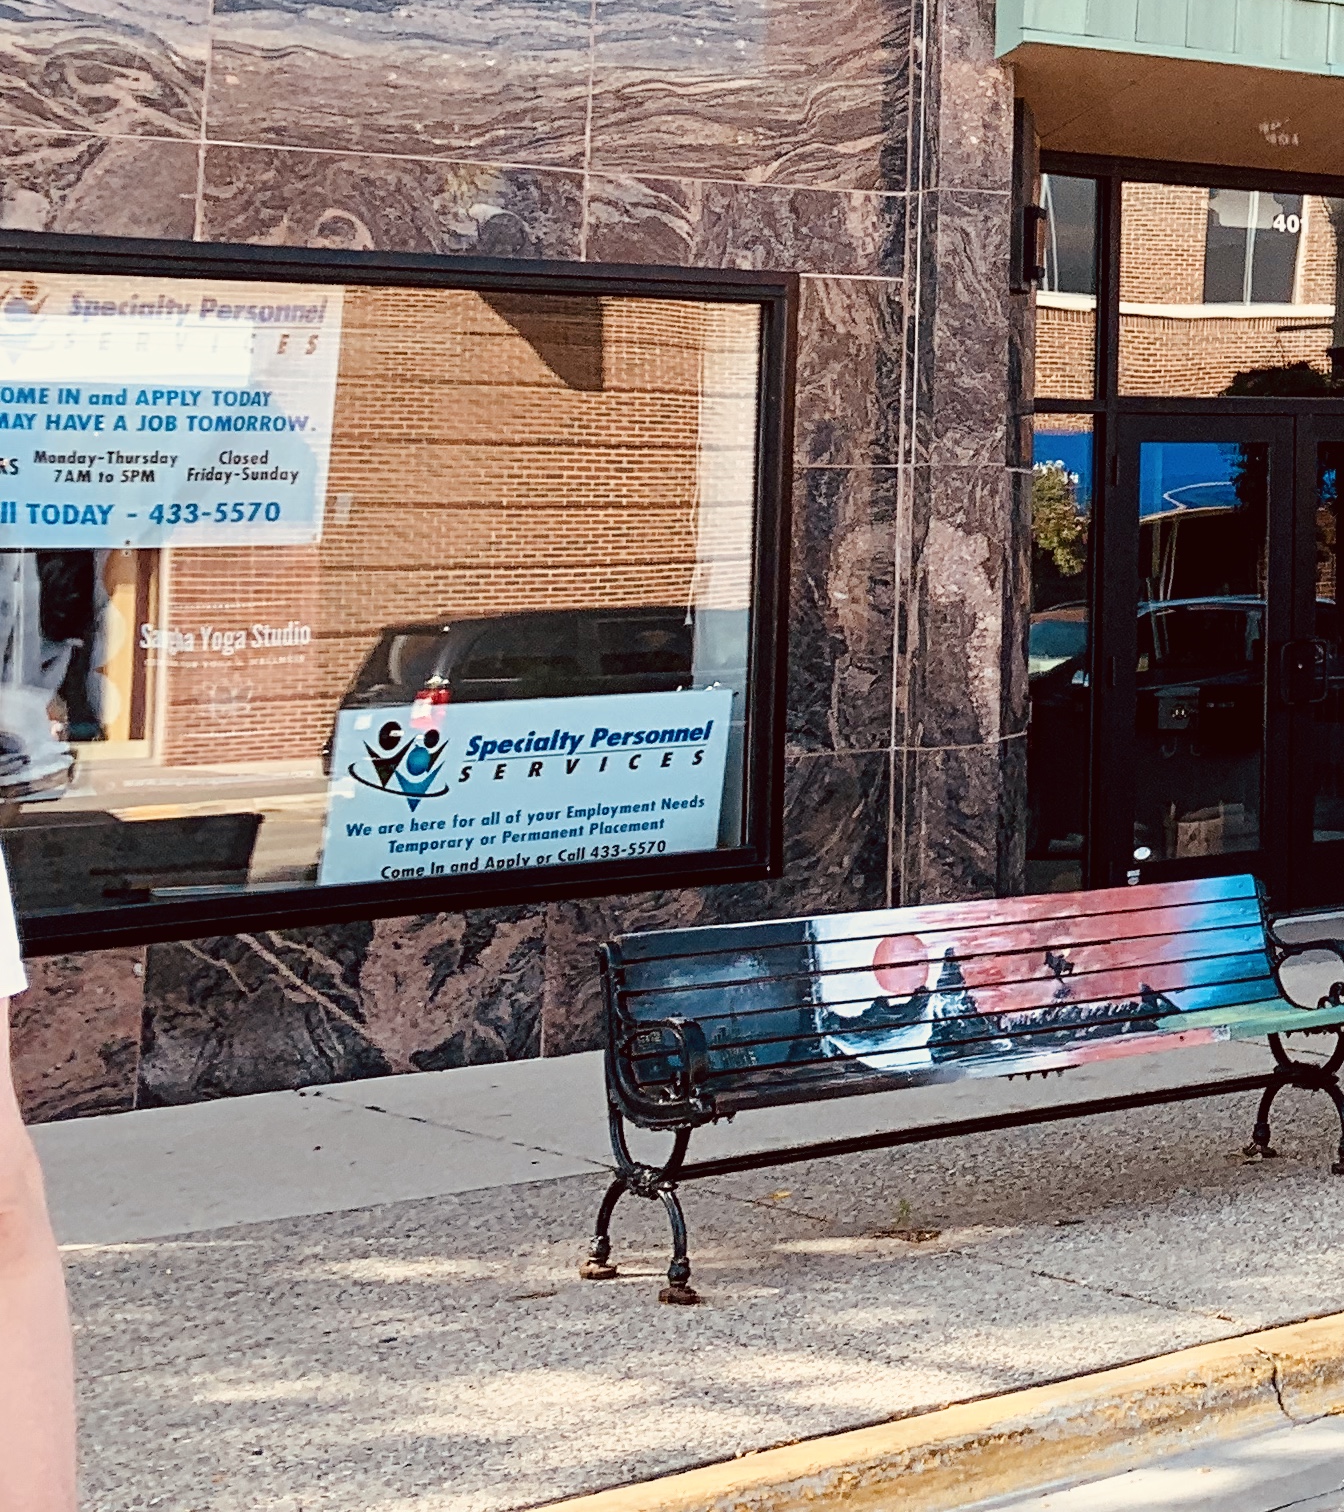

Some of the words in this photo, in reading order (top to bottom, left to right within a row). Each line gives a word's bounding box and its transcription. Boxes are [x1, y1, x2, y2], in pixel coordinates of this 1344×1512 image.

[1272, 214, 1307, 233] 40
[69, 291, 191, 327] Specialty
[199, 294, 328, 324] Personnel
[58, 388, 80, 405] IN
[89, 389, 127, 406] and
[135, 390, 201, 407] APPLY
[211, 390, 273, 407] TODAY
[45, 413, 105, 431] HAVE
[113, 414, 127, 431] A
[136, 415, 177, 432] JOB
[186, 414, 317, 433] TOMORROW.
[33, 450, 178, 467] Monday-Thursday
[218, 449, 269, 465] Closed
[53, 469, 92, 483] 7AM
[99, 469, 114, 483] to
[120, 469, 155, 483] 5PM
[186, 467, 299, 485] Friday-Sunday
[26, 503, 115, 525] TODAY
[148, 501, 281, 525] 433-5570
[200, 625, 247, 656] Yoga
[251, 621, 312, 648] Studio
[466, 729, 584, 762] Specialty
[590, 719, 714, 749] Personnel
[458, 749, 704, 783] SERVICES
[346, 823, 372, 837] We
[378, 821, 404, 835] are
[410, 818, 446, 833] here
[452, 813, 476, 829] for
[481, 811, 500, 826] all
[505, 809, 522, 824] of
[528, 809, 561, 825] your
[566, 800, 656, 820] Employment
[661, 794, 706, 811] Needs
[388, 837, 474, 855] Temporary
[480, 833, 497, 846] or
[502, 825, 584, 844] Permanent
[589, 818, 665, 836] Placement
[381, 865, 425, 880] Come
[431, 862, 445, 875] In
[450, 857, 479, 874] and
[485, 853, 530, 870] Apply
[536, 852, 553, 865] or
[557, 847, 585, 863] Call
[590, 840, 667, 860] 433-5570
